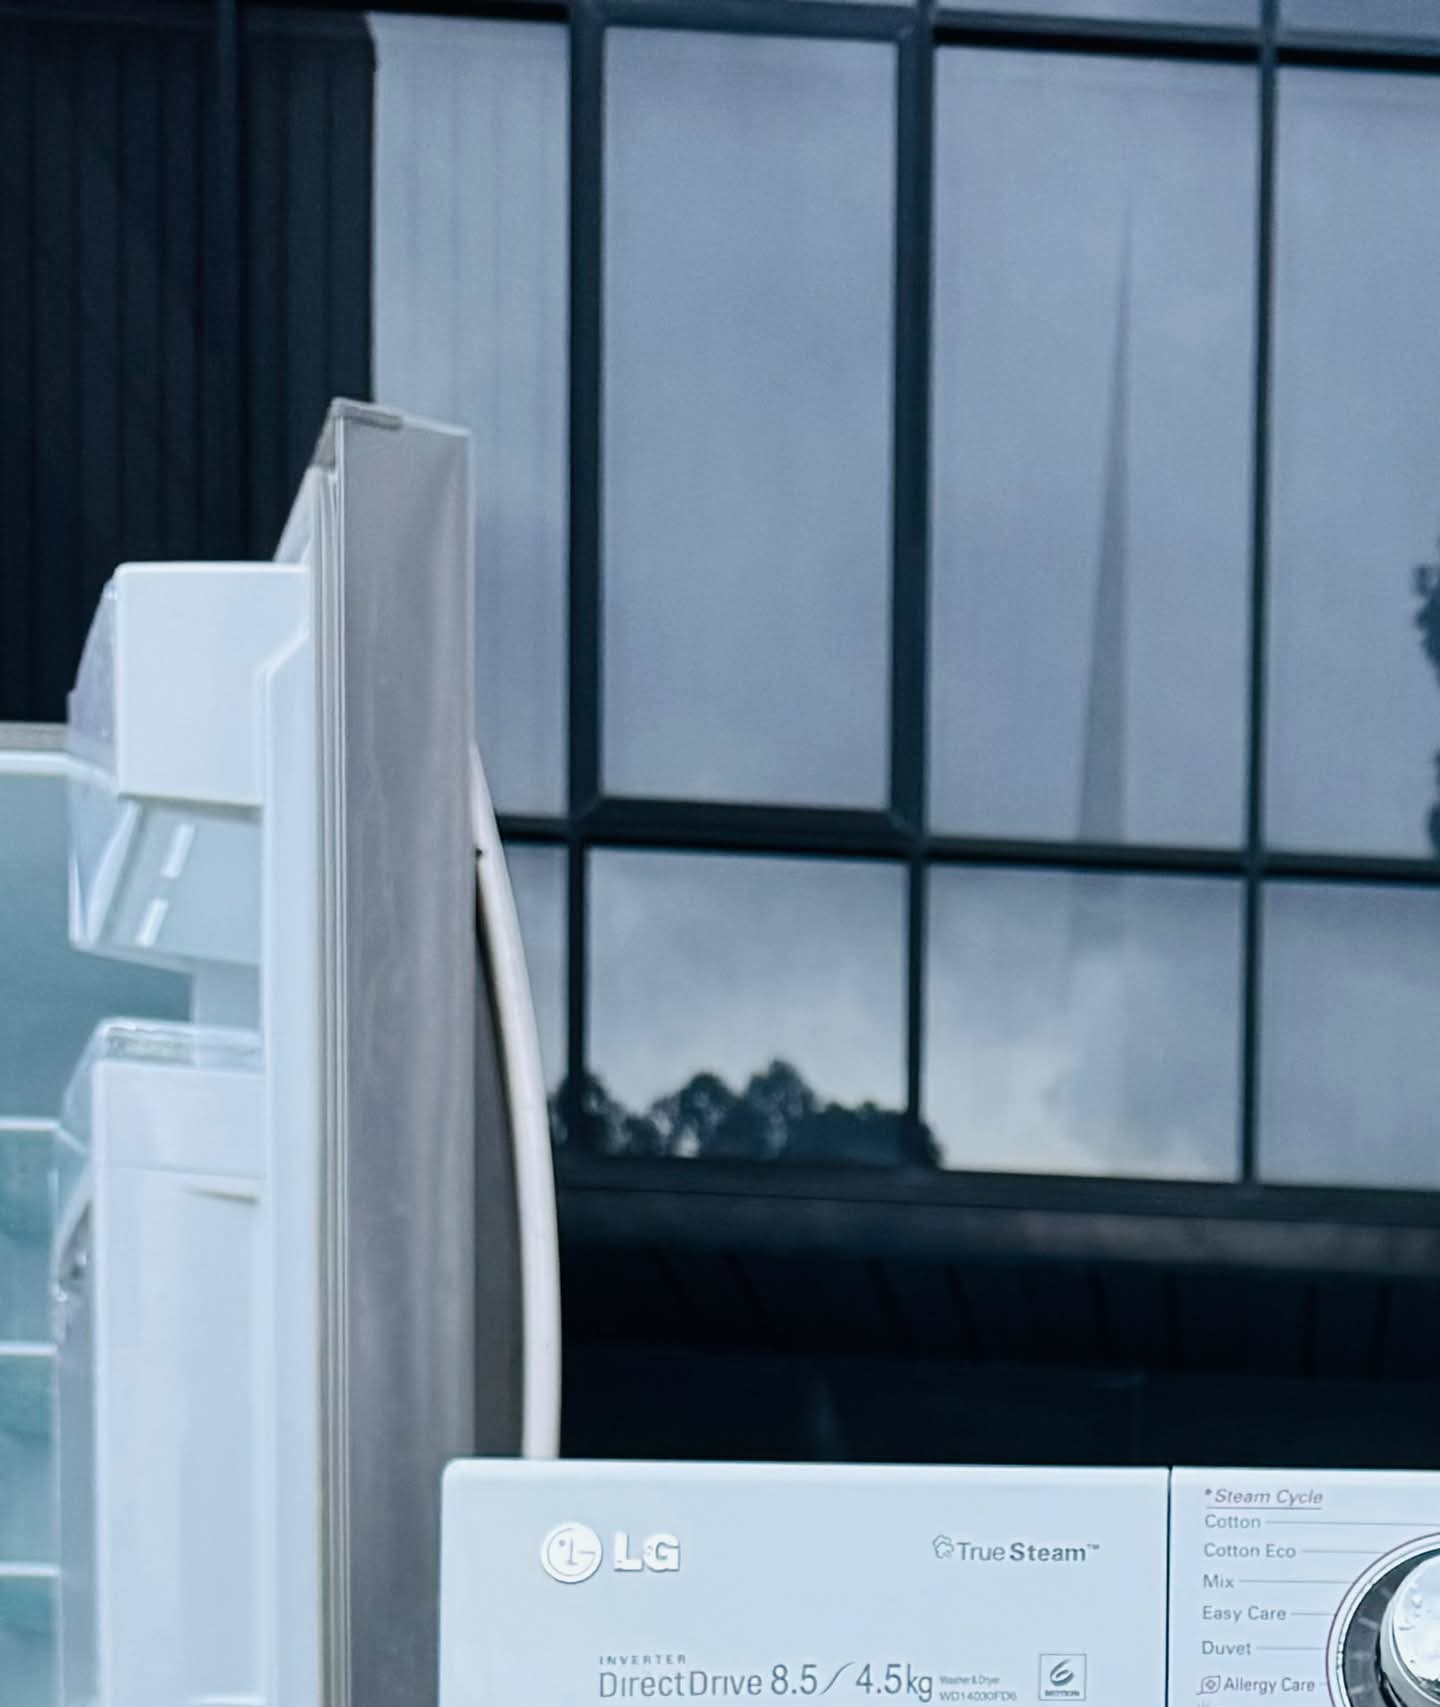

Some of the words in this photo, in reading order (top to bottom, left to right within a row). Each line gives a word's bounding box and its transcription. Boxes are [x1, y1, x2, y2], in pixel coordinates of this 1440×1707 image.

[1276, 1489, 1324, 1507] Cycle
[1204, 1514, 1262, 1529] Cotton
[613, 1531, 681, 1573] LG
[1203, 1542, 1260, 1558] Cotton
[1265, 1543, 1297, 1559] Eco
[1202, 1573, 1235, 1589] Mix
[1202, 1605, 1242, 1623] Easy
[1247, 1605, 1287, 1621] Care
[1201, 1640, 1252, 1656] Duvet
[599, 1653, 687, 1666] INVERTER
[1223, 1677, 1278, 1696] Allergy
[1280, 1677, 1316, 1693] Care
